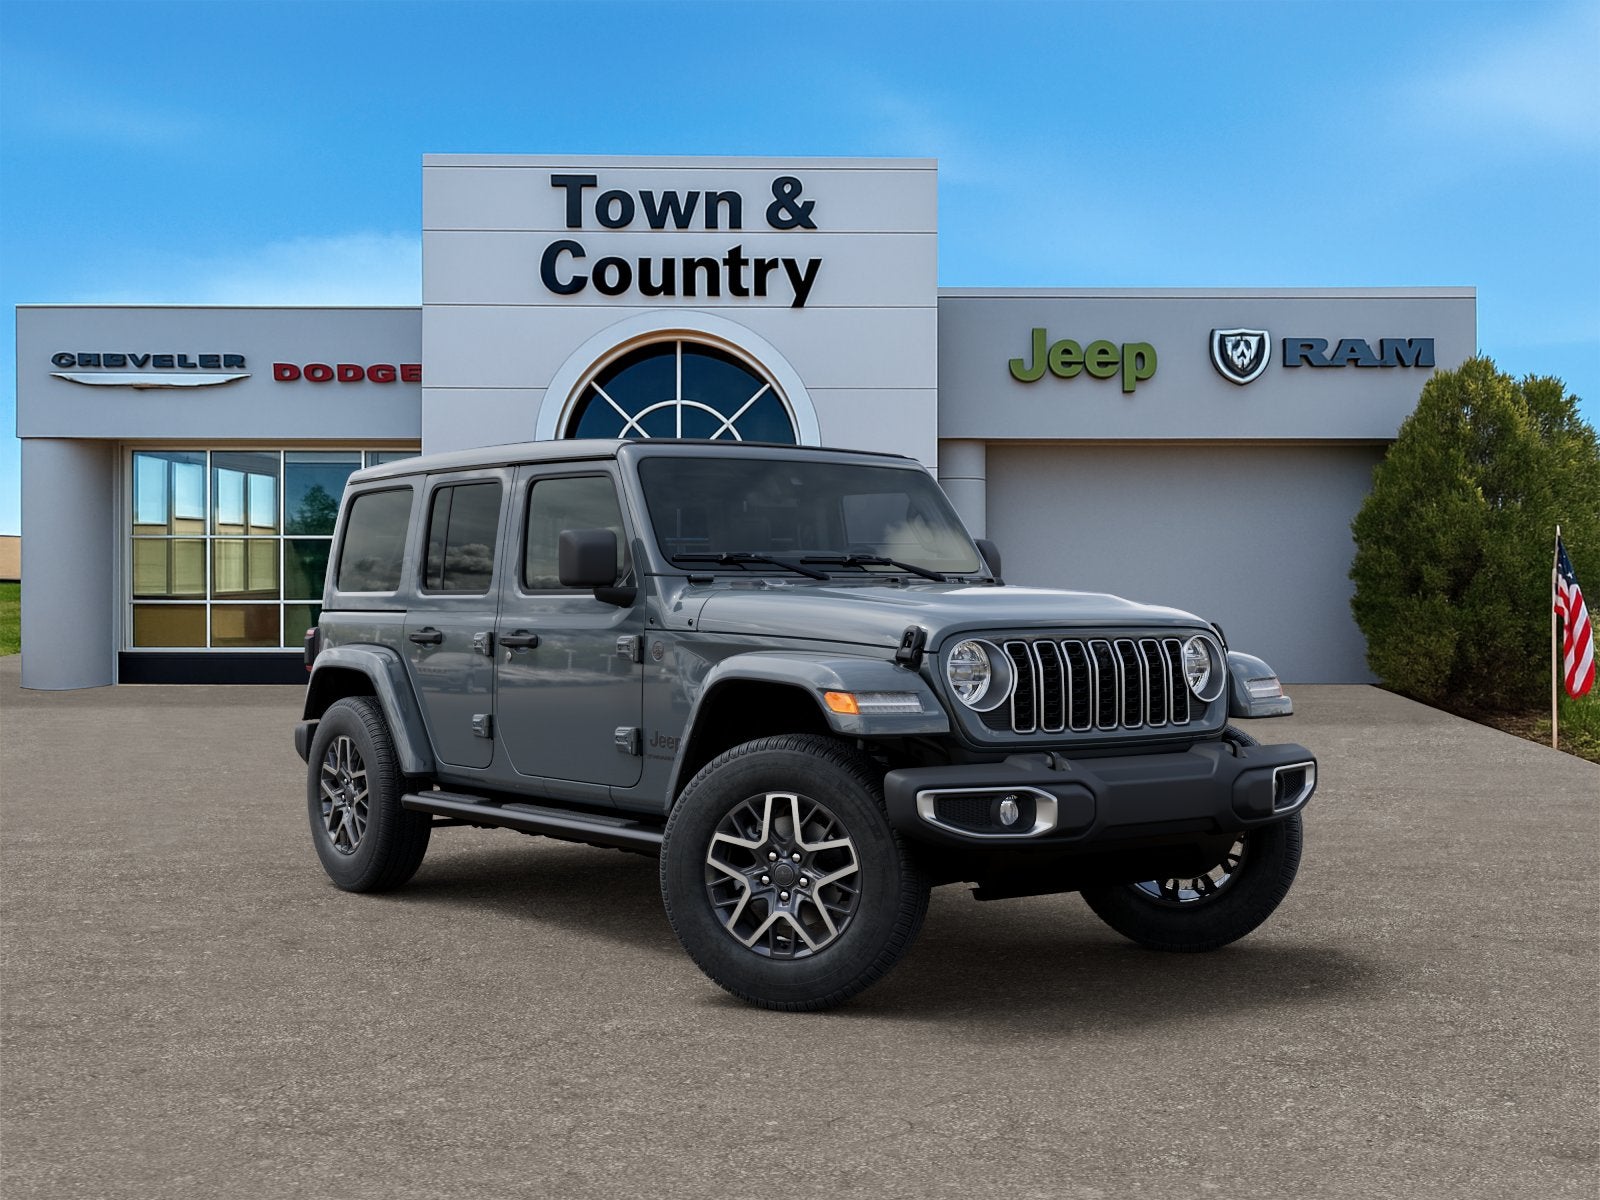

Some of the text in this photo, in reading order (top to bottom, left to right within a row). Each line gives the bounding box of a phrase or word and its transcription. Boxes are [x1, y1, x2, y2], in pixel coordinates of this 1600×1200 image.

[550, 174, 818, 230] Town &
[540, 239, 822, 308] Country
[273, 363, 422, 383] DODGE
[1009, 328, 1157, 392] Jeep
[1282, 337, 1435, 368] RAM
